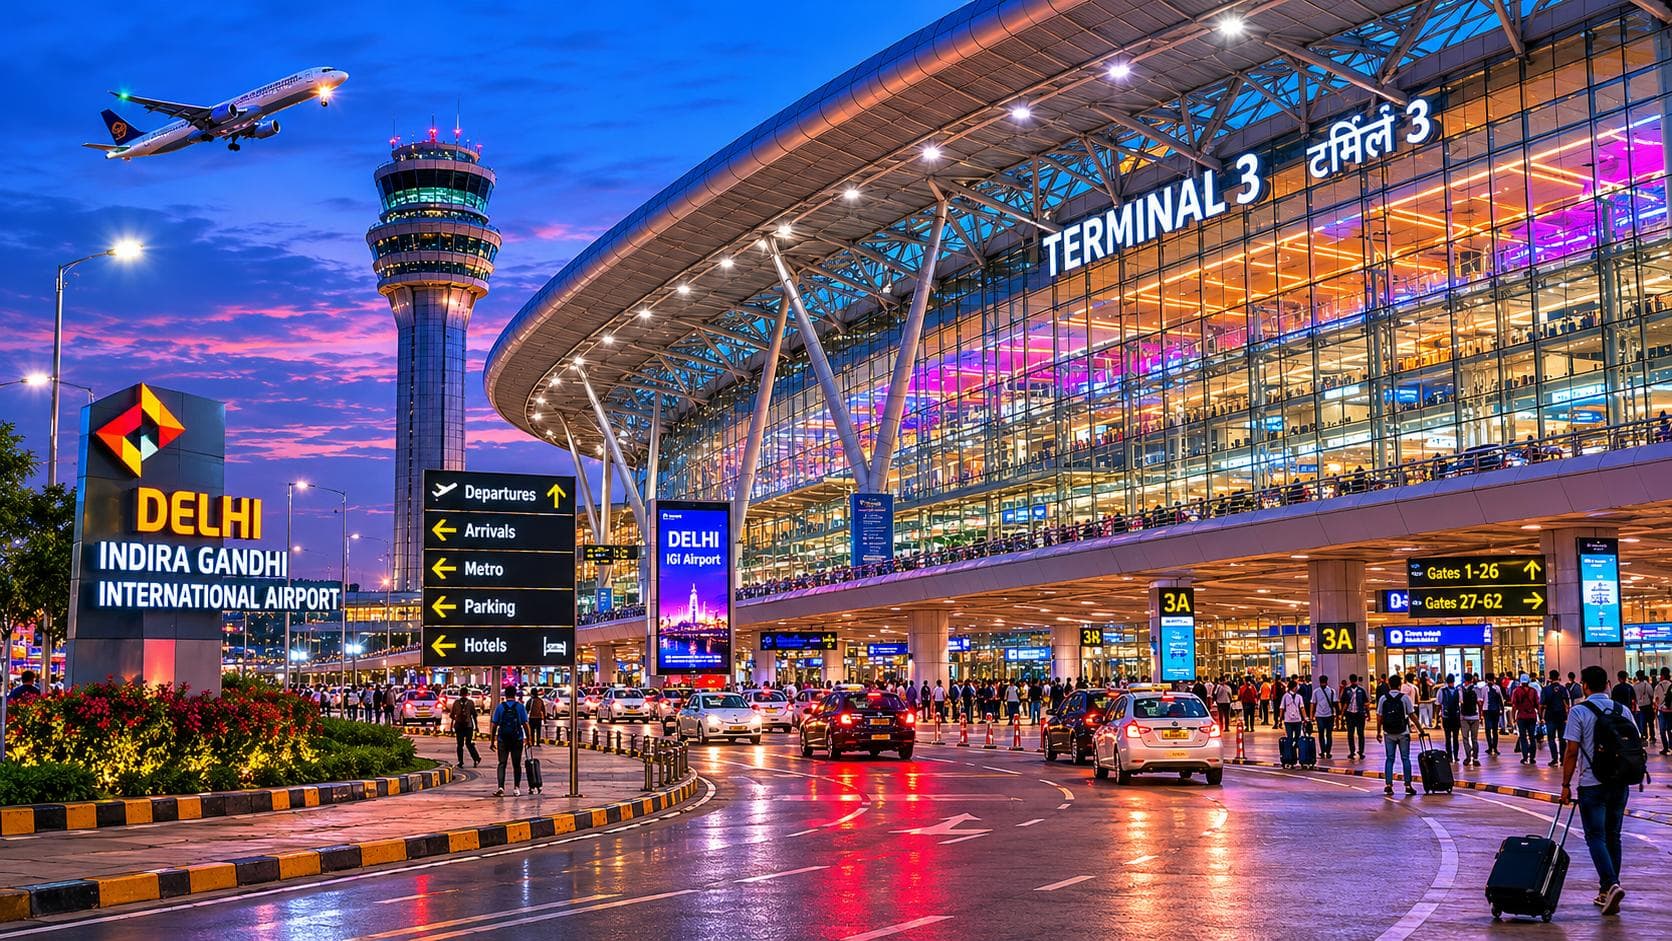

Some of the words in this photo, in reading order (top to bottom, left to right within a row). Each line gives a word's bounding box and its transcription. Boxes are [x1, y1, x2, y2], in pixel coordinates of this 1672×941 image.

[1042, 170, 1226, 277] TERMINAL
[1236, 153, 1261, 205] 3
[464, 484, 537, 503] Departures
[137, 487, 262, 539] DELHI
[464, 522, 517, 539] Arrivals
[668, 530, 719, 548] DELHI
[100, 541, 190, 573] INDIRA
[198, 547, 288, 576] GANDHI
[683, 553, 721, 567] Airport
[464, 561, 504, 577] Metro
[1427, 566, 1461, 580] Gates
[1464, 562, 1500, 579] 1-26
[99, 580, 260, 609] INTERNATIONAL
[264, 586, 340, 611] AIRPORT
[1163, 592, 1191, 613] 3A
[1425, 596, 1457, 610] Gates
[1459, 593, 1503, 610] 27-62
[464, 598, 517, 618] Parking
[464, 637, 508, 653] Hotels
[1322, 628, 1354, 650] 3A
